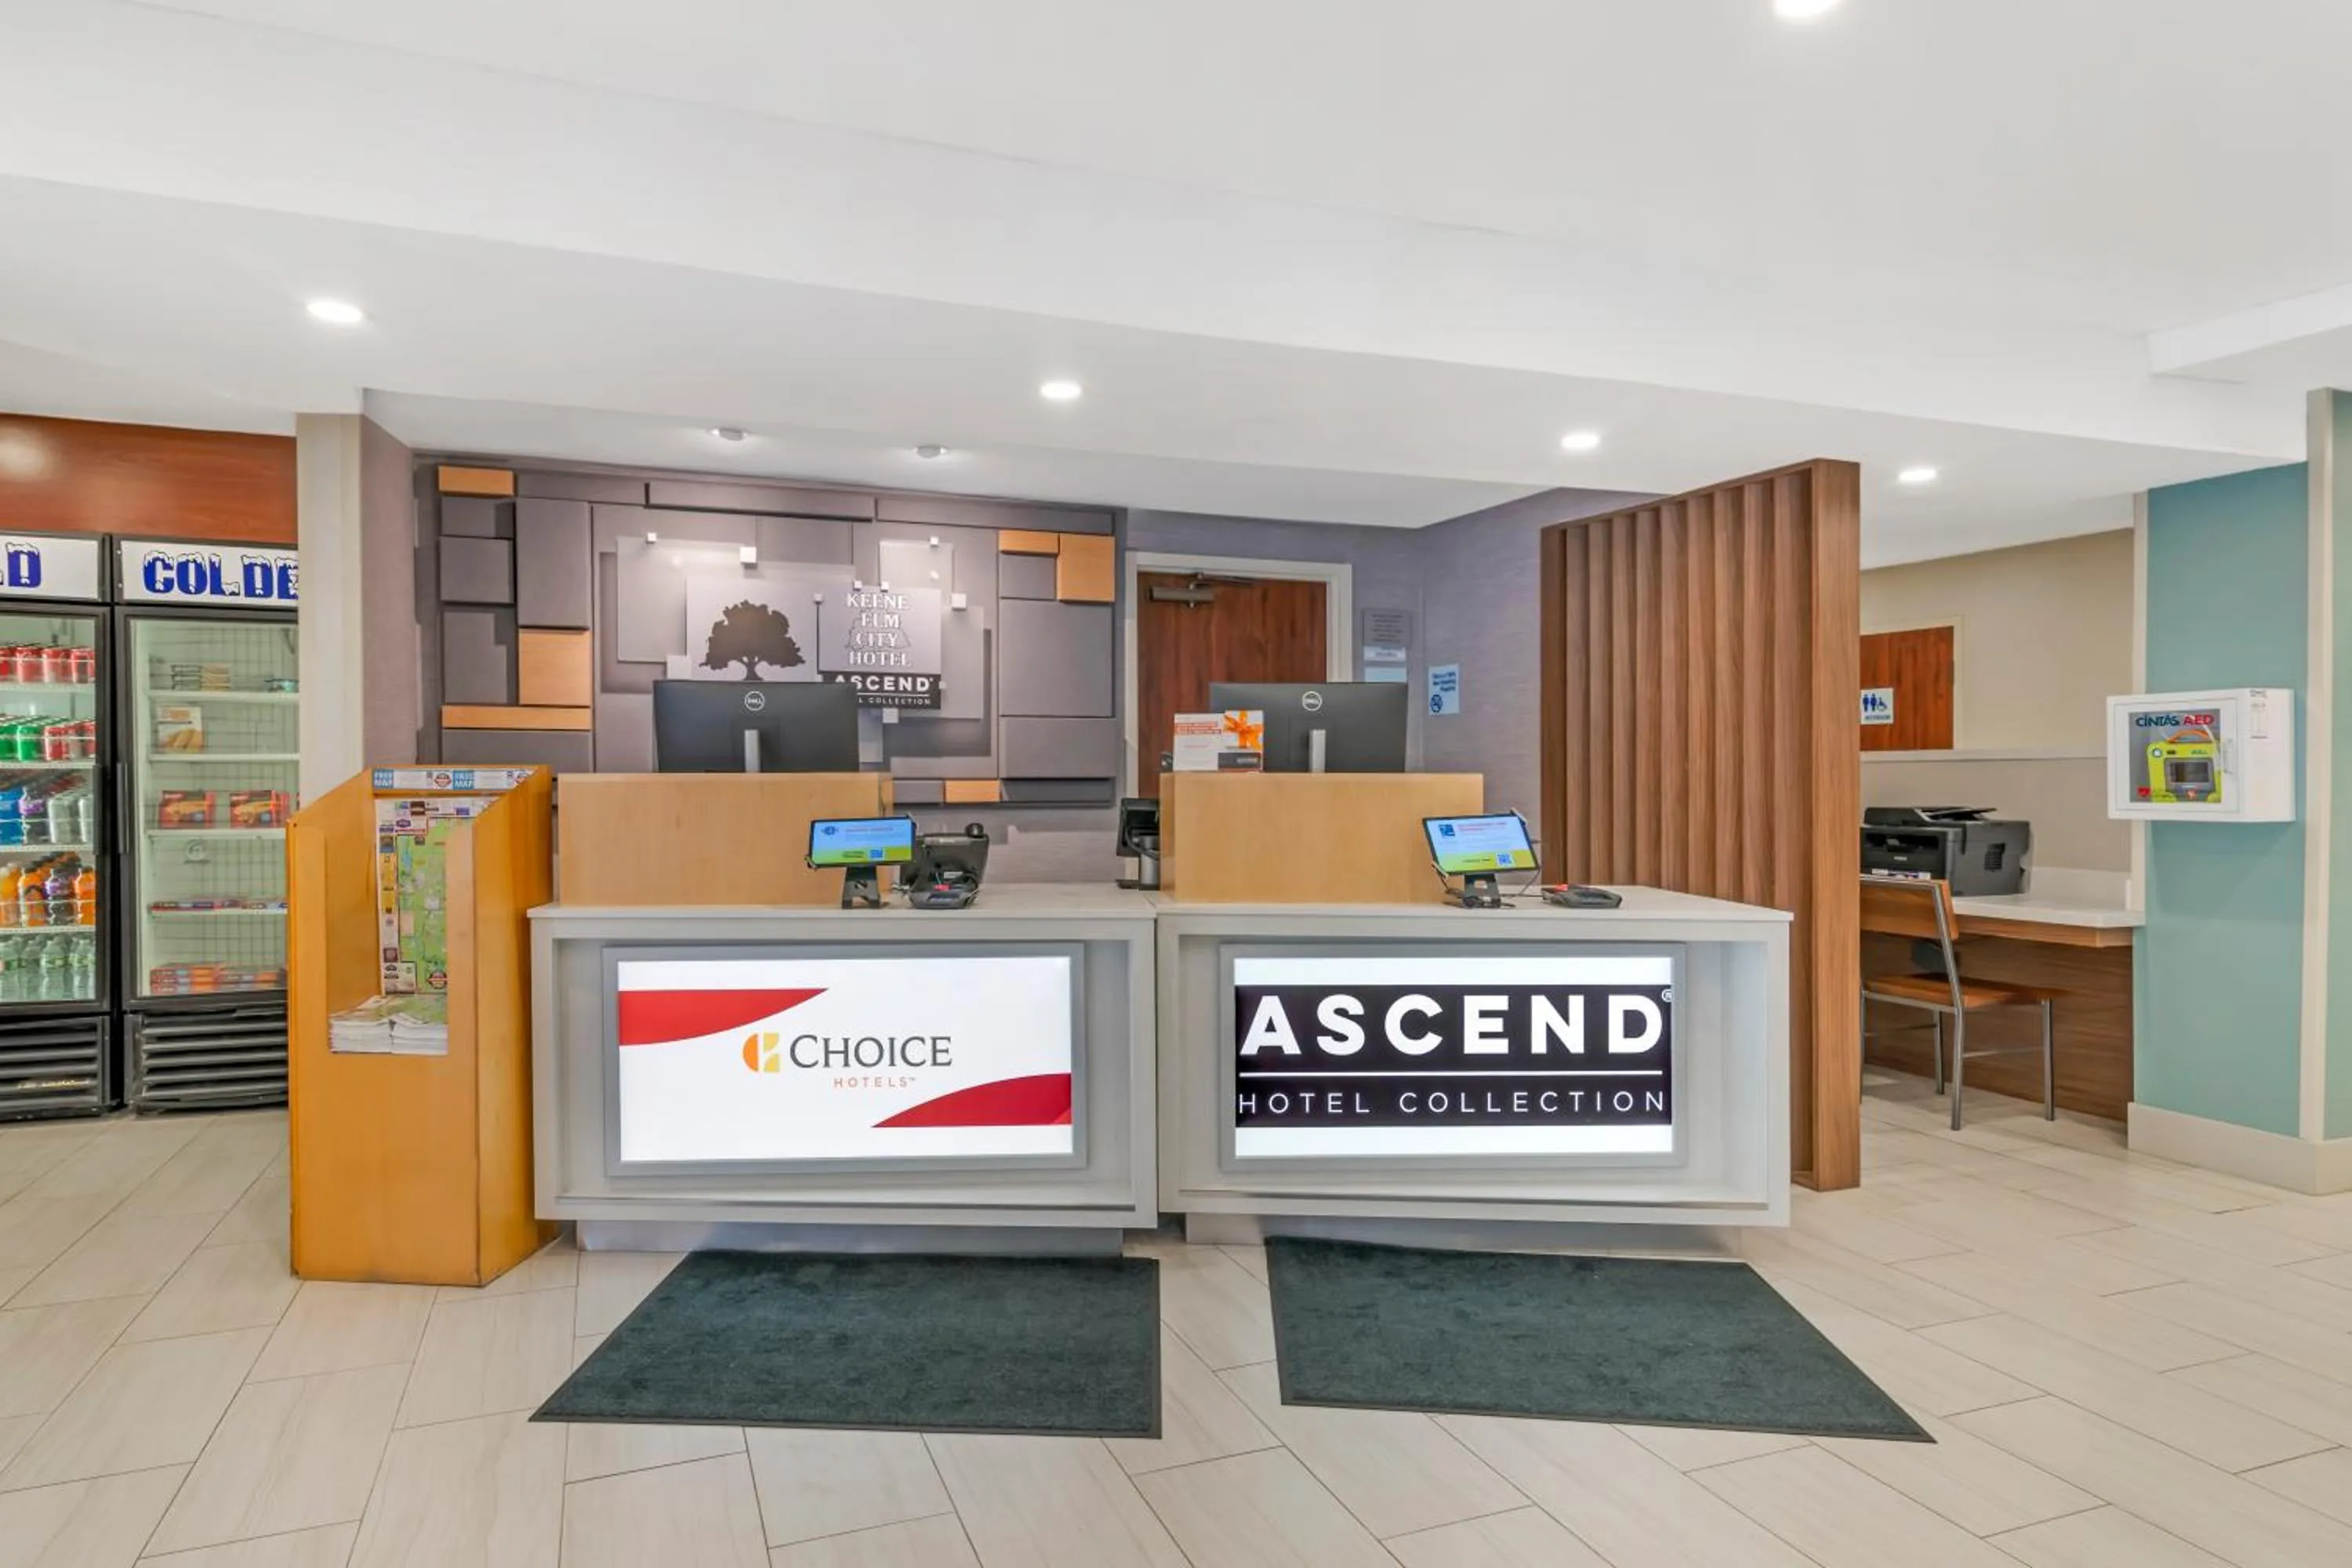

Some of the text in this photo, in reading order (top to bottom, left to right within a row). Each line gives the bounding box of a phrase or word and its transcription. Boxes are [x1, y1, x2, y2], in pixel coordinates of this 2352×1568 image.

[846, 593, 910, 610] KEENE
[861, 612, 900, 628] ELM
[855, 633, 898, 648] CITY
[849, 652, 913, 666] HOTEL
[869, 697, 931, 706] COLLECTION
[2183, 714, 2215, 726] AED
[789, 1034, 953, 1069] CHOICE
[1239, 1091, 1664, 1114] HOTEL COLLECTION
